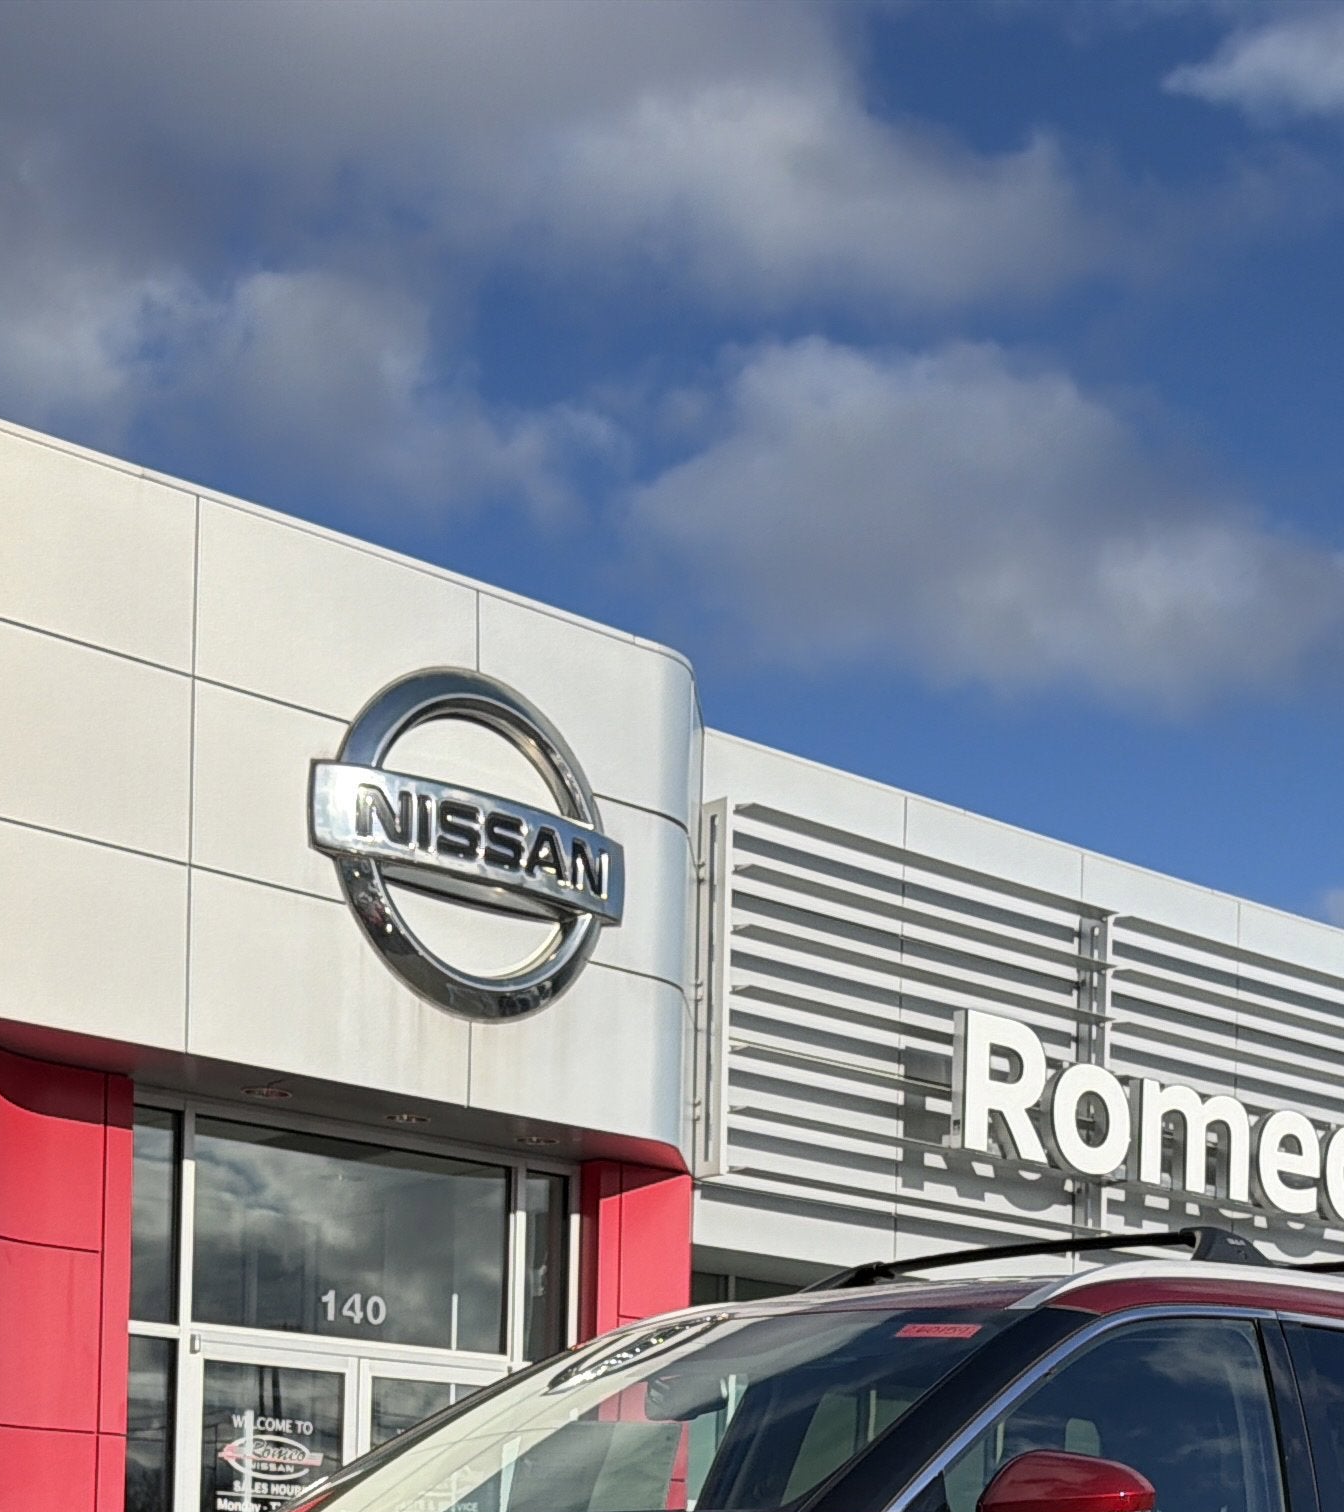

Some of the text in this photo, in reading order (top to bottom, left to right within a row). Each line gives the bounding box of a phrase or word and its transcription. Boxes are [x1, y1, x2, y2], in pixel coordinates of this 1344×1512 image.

[356, 783, 609, 900] NISSAN
[321, 1289, 386, 1326] 140
[232, 1414, 313, 1435] WCOME TO
[233, 1480, 268, 1495] SES
